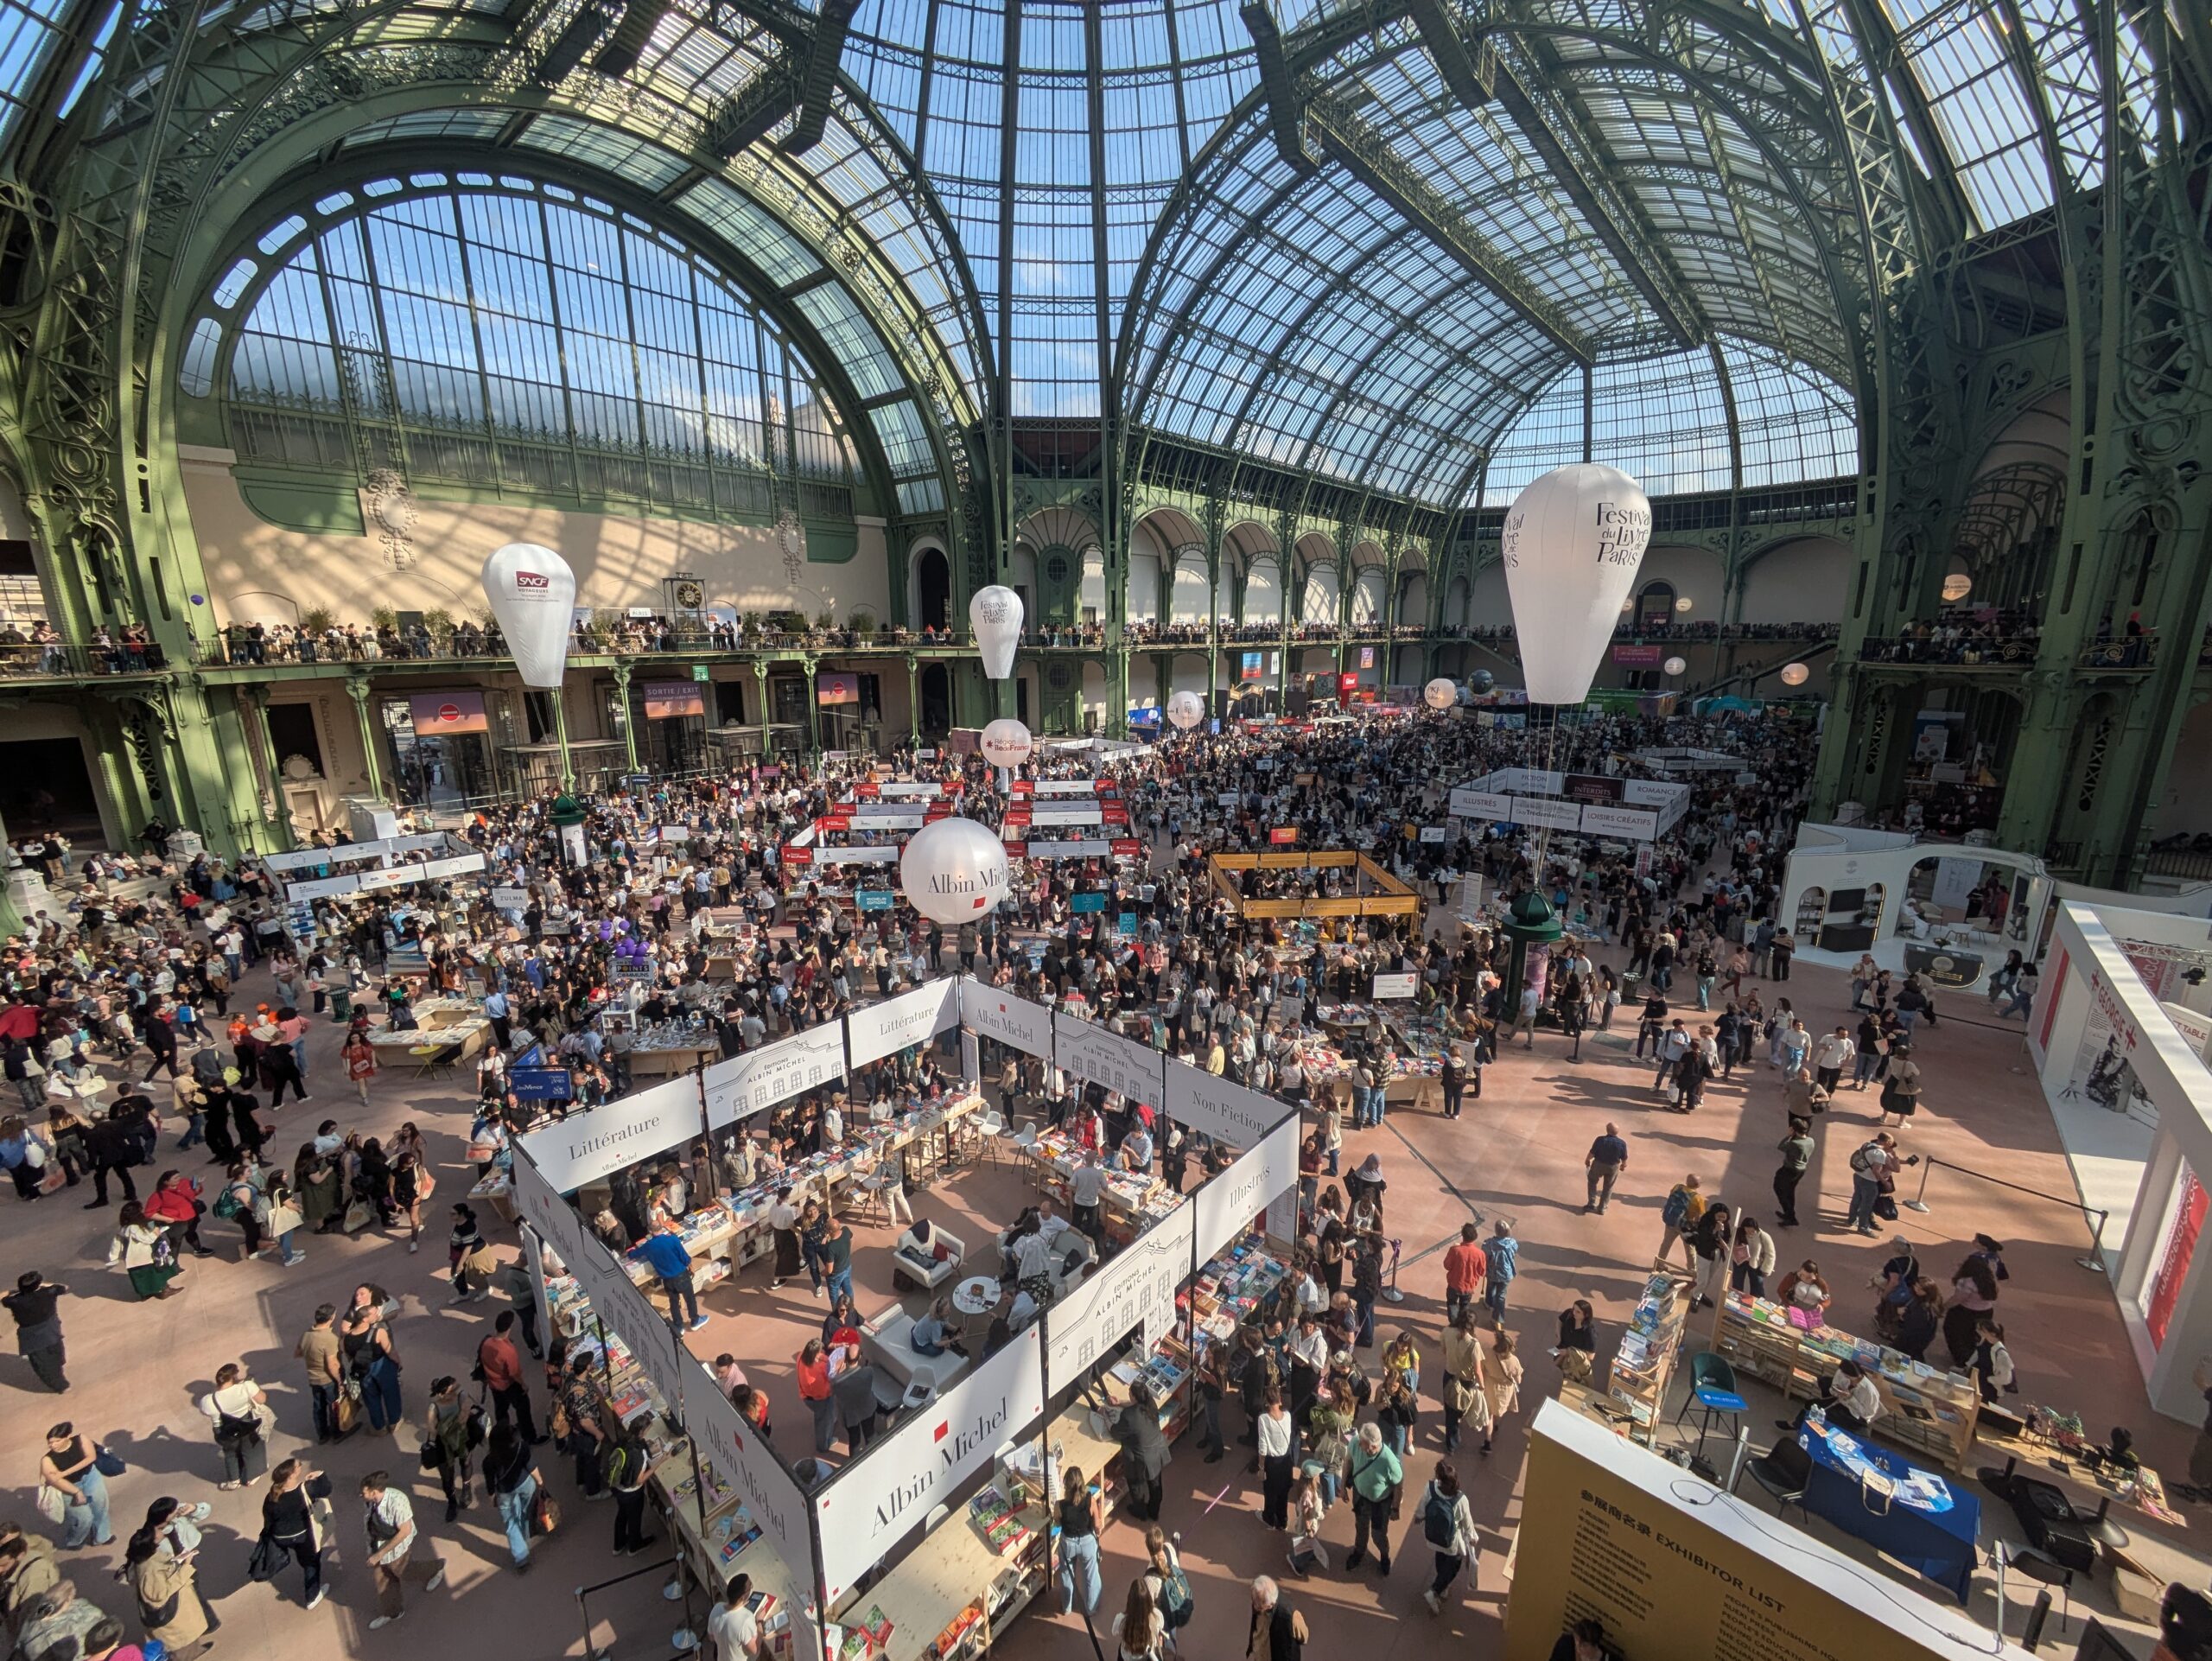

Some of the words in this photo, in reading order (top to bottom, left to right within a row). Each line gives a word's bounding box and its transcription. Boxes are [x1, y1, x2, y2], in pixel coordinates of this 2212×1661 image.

[1602, 527, 1616, 539] du
[518, 577, 547, 586] SNCF
[1521, 773, 1548, 782] FICTION
[1637, 786, 1677, 796] ROMANCE
[1587, 811, 1615, 822] LOISIRS
[1617, 813, 1651, 825] CRÉATIFS
[928, 874, 975, 894] Albin
[880, 1007, 935, 1036] Littérature
[976, 1008, 1000, 1030] Albin
[1001, 1018, 1034, 1043] Michel
[2098, 984, 2126, 1038] GÉORGIE
[2183, 1025, 2208, 1041] TABLE
[747, 1071, 772, 1085] ALBIN
[776, 1056, 806, 1072] MICHEL
[1084, 1046, 1102, 1057] ALBIN
[1105, 1055, 1128, 1069] MICHEL
[1192, 1091, 1216, 1113] Non
[1221, 1103, 1266, 1135] Fiction
[569, 1116, 660, 1161] Littérature
[601, 1162, 617, 1172] Albin
[618, 1152, 638, 1167] Michel
[1230, 1164, 1270, 1209] Illustrés
[1096, 1292, 1122, 1319] ALBIN
[1127, 1263, 1156, 1293] MICHEL
[704, 1416, 738, 1474] Albin
[741, 1461, 786, 1541] Michel
[870, 1469, 934, 1539] Albin
[939, 1396, 1008, 1476] Michel
[1580, 1489, 1651, 1537] 参展商名录
[1656, 1532, 1744, 1591] EXHIBITOR
[1748, 1586, 1786, 1613] LIST
[1749, 1618, 1776, 1638] PRESS
[1764, 1618, 1818, 1653] PUBLISHING
